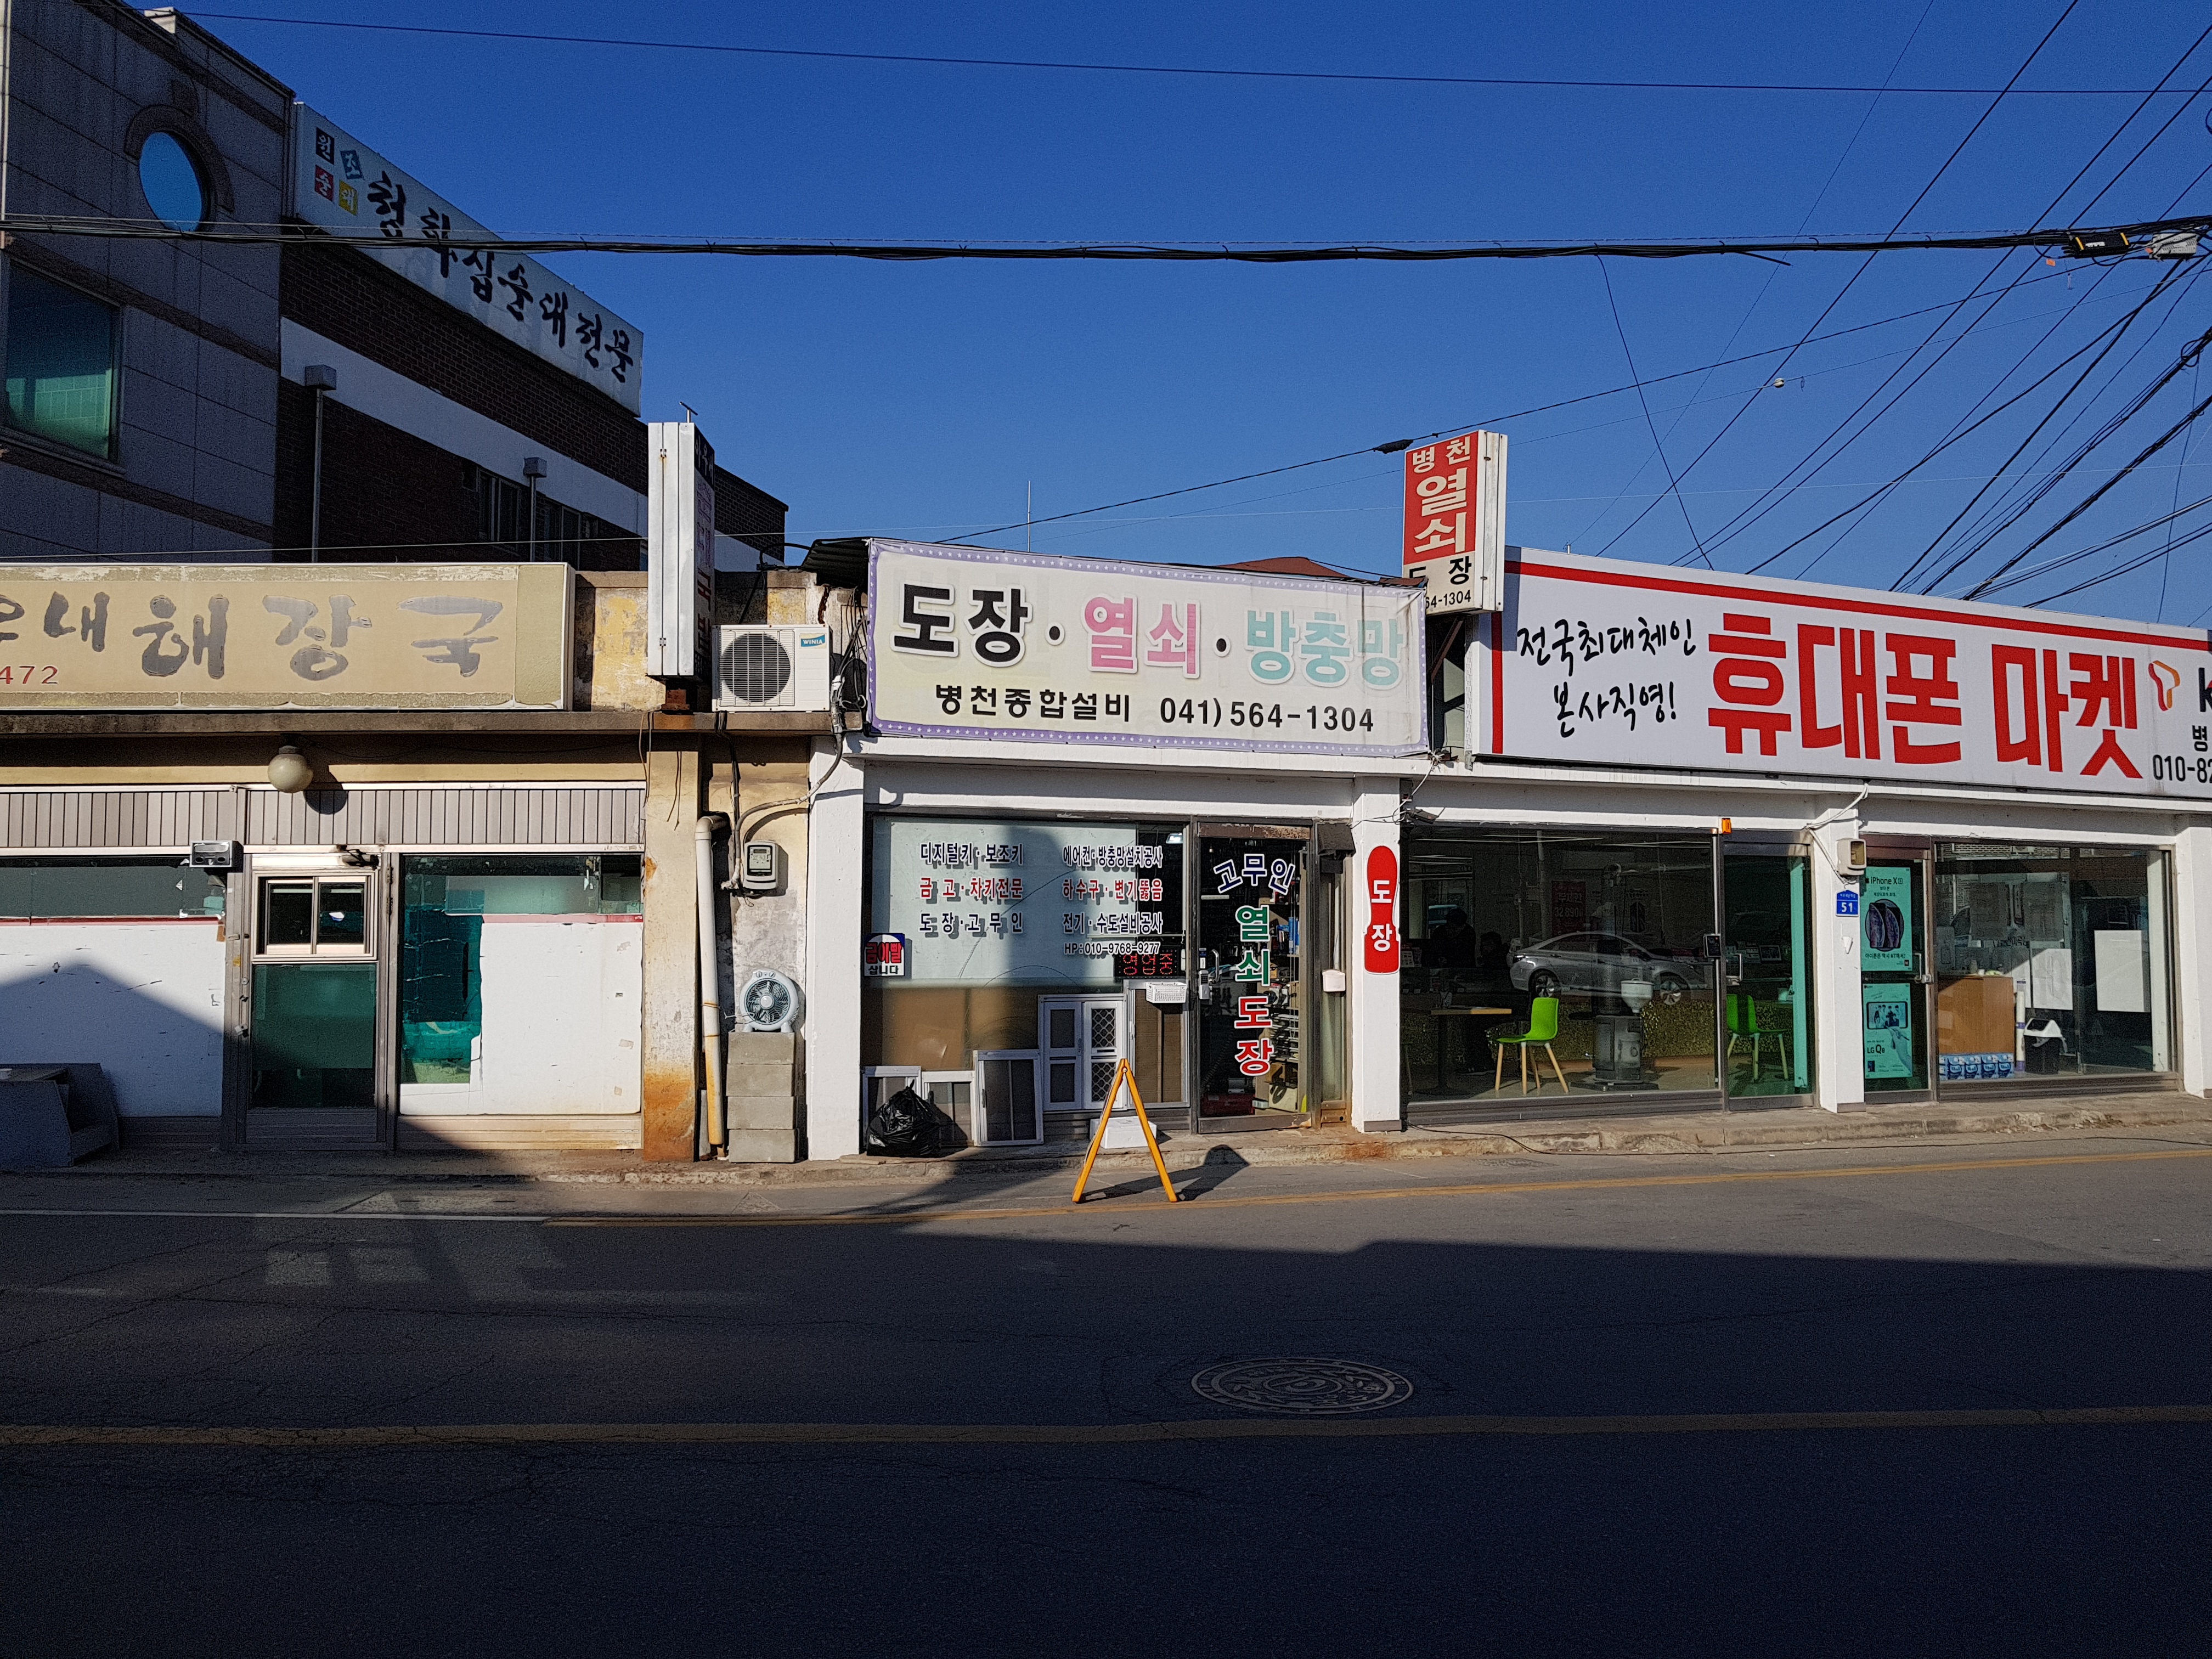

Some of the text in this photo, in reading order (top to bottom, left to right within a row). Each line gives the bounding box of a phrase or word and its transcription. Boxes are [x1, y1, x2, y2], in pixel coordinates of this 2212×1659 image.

[1413, 436, 1471, 473] 병천
[1414, 467, 1468, 554] 열쇠
[893, 582, 1402, 687] 도장 열쇠 방충망
[1516, 617, 1697, 676] 전국최대체인
[936, 684, 1374, 732] 병천종합설비 041)564-1304
[1554, 681, 1677, 738] 본사직영!
[1707, 612, 2143, 780] 휴대폰 마켓
[1213, 854, 1295, 896] 고무인
[1871, 876, 1892, 884] iPhone
[1370, 879, 1393, 952] 도장
[1841, 901, 1853, 913] 51
[865, 941, 903, 964] 금이빨
[868, 965, 899, 975] 삽니다
[1123, 953, 1173, 975] 영업중
[1234, 905, 1271, 987] 열쇠
[1234, 996, 1274, 1076] 도장
